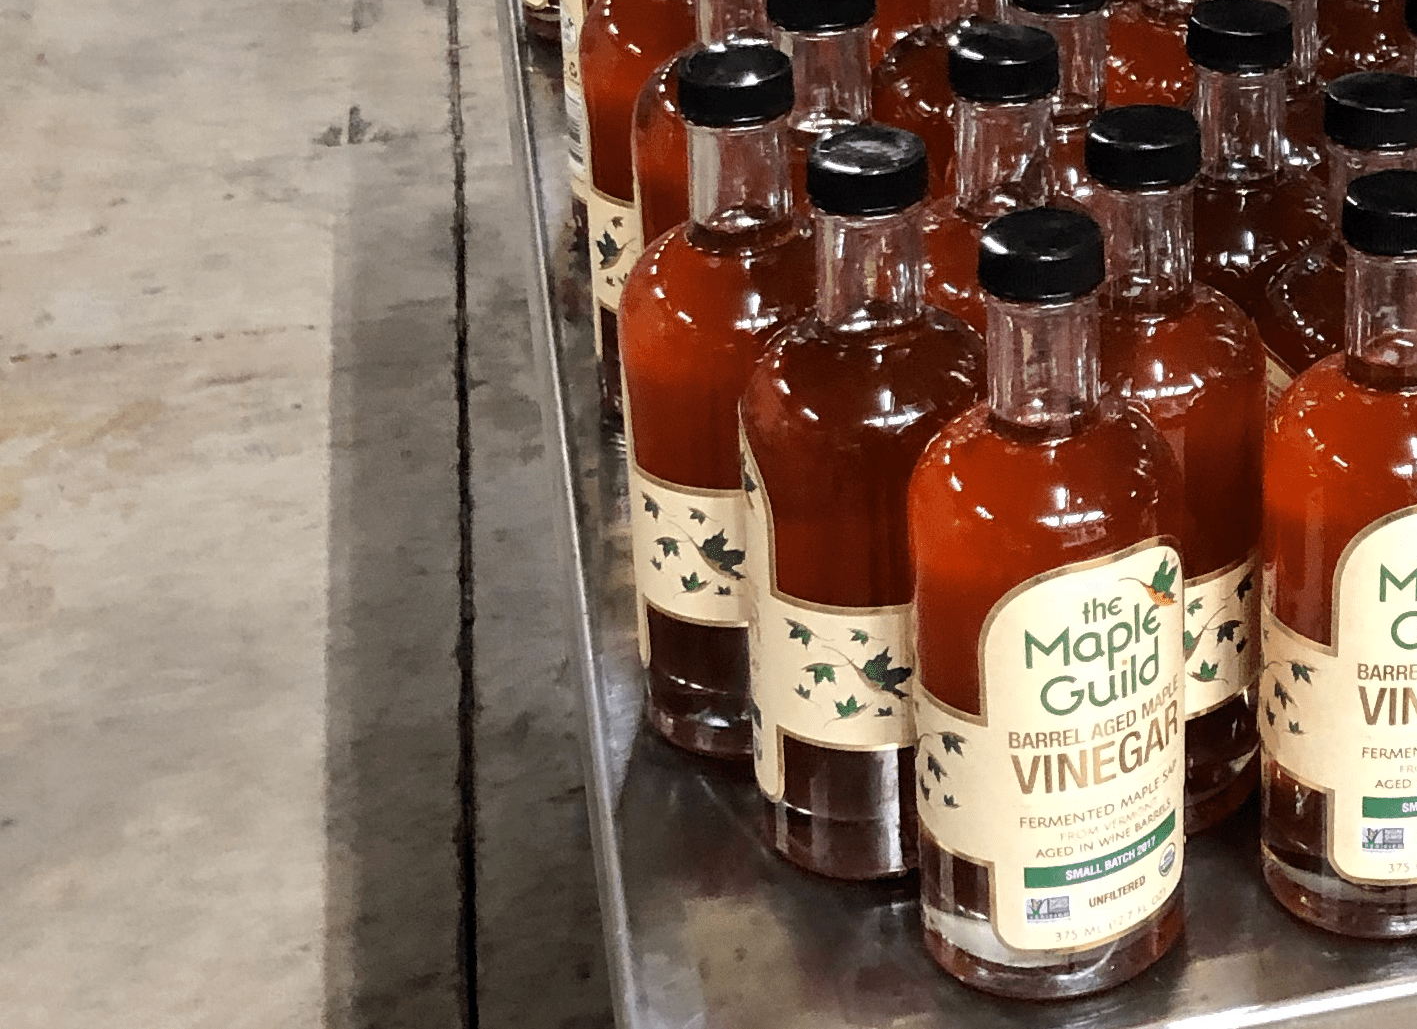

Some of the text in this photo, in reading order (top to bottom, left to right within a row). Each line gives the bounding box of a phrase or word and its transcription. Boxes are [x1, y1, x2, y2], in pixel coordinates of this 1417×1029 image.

[1082, 596, 1122, 624] the
[1024, 603, 1161, 672] Maple
[1040, 634, 1159, 716] Guild
[1008, 673, 1178, 749] BARREL AGED MAPLE
[1011, 699, 1178, 795] VINEGAR
[1019, 803, 1115, 829] FERMENTED
[1120, 777, 1159, 809] MAPLE
[1375, 778, 1412, 789] AGED
[1036, 797, 1171, 859] AGED IN WINE BARRELS
[1065, 835, 1156, 881] SMALL BATCH 2017
[1388, 861, 1410, 874] 375
[1088, 875, 1146, 908] UNFILTERED
[1055, 930, 1078, 943] 375
